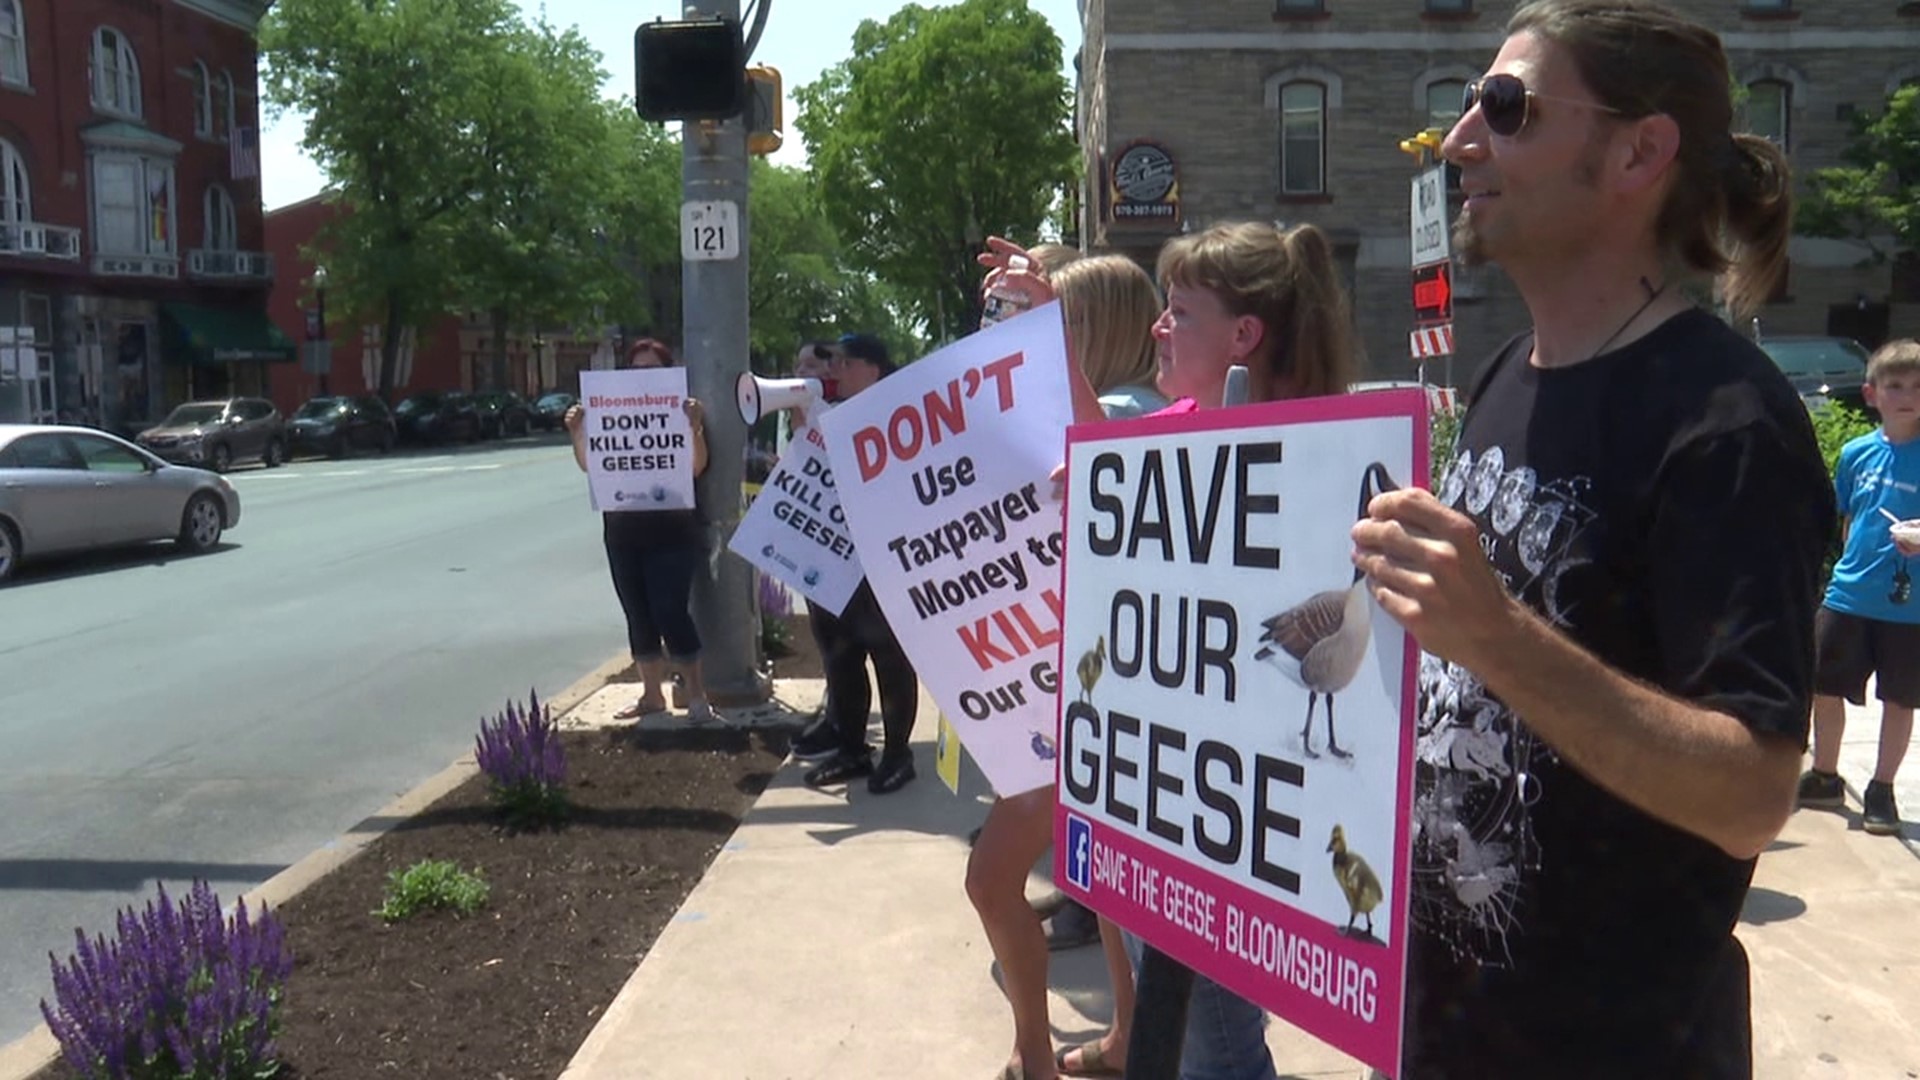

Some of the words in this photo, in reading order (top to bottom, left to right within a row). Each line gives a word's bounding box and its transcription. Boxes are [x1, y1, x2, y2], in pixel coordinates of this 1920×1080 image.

[694, 226, 724, 251] 121
[589, 394, 679, 409] Bloomsburg
[852, 351, 1024, 483] DON'T
[589, 435, 635, 452] KILL
[639, 434, 685, 450] OUR
[602, 454, 675, 471] GEESE!
[773, 469, 823, 512] KILL
[802, 456, 837, 490] DO
[911, 455, 977, 507] Use
[773, 500, 855, 561] GEESE!
[887, 482, 1041, 573] Taxpayer
[1087, 442, 1282, 570] SAVE
[907, 551, 1028, 621] Money
[1026, 531, 1063, 567] to
[1109, 588, 1239, 703] OUR
[958, 677, 1028, 721] Our
[1063, 700, 1305, 897] GEESE
[1093, 841, 1127, 895] SAVE
[1130, 856, 1159, 913] THE
[1163, 875, 1219, 952] GEESE,
[1225, 903, 1378, 1024] BLOOMSBURG
